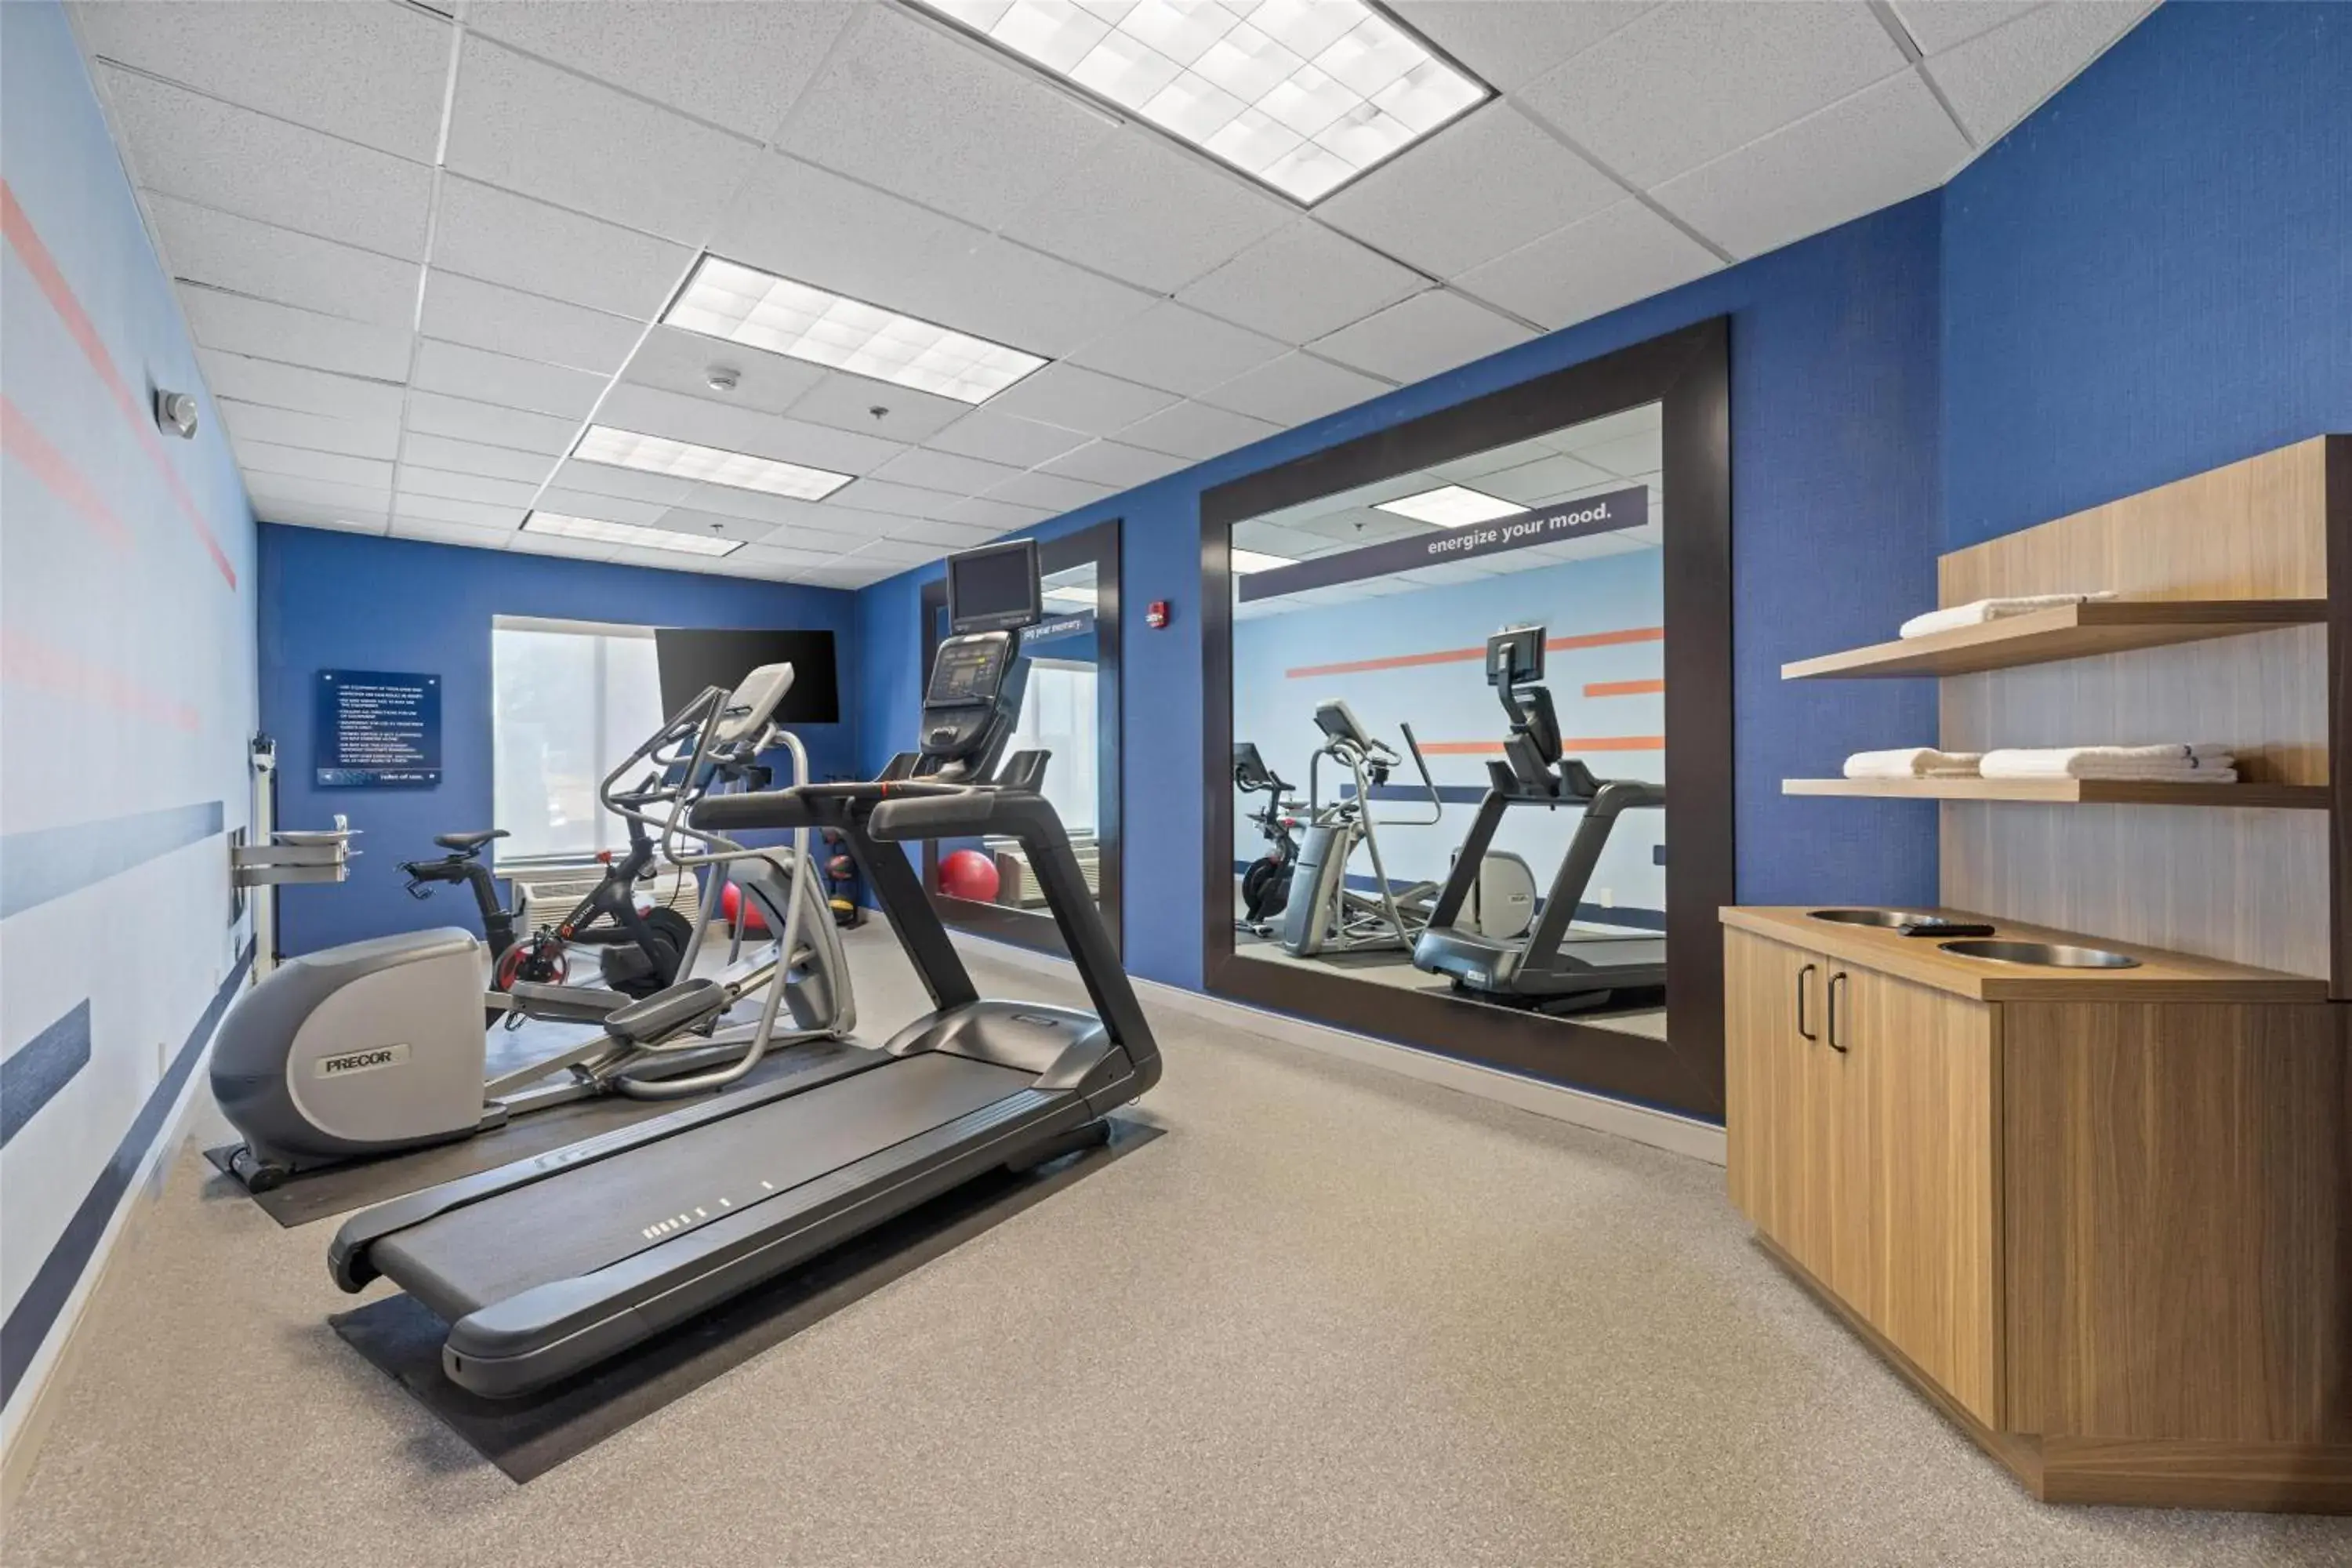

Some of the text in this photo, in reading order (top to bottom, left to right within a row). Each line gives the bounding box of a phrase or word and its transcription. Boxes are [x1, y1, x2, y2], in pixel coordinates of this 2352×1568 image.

[1428, 502, 1612, 554] energize your mood.
[325, 1050, 392, 1073] PRECOR
